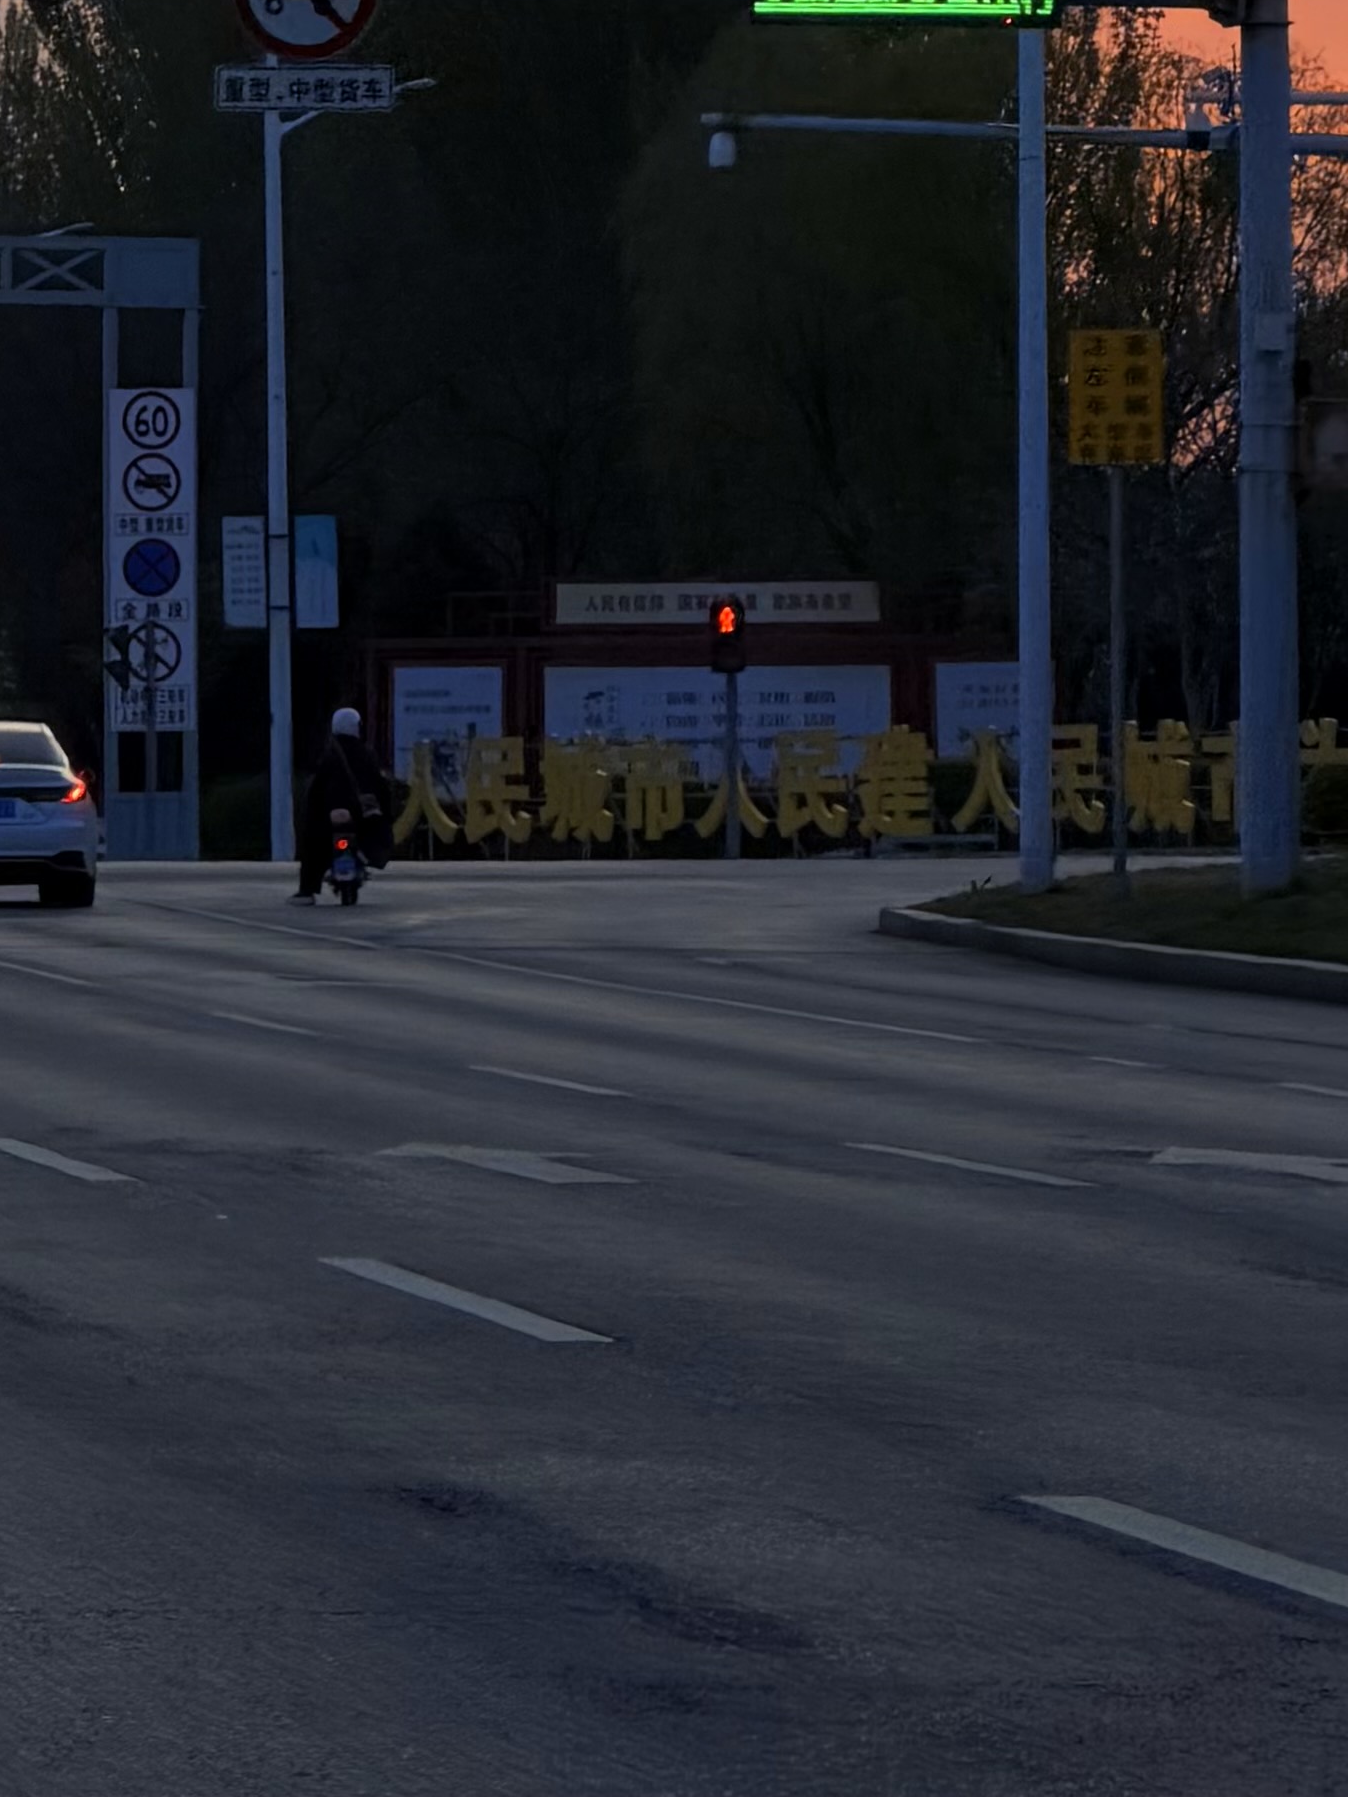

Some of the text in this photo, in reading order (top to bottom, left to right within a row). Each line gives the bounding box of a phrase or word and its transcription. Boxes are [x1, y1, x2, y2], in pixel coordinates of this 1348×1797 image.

[134, 405, 169, 437] 60
[393, 723, 935, 845] 人民城市人民建
